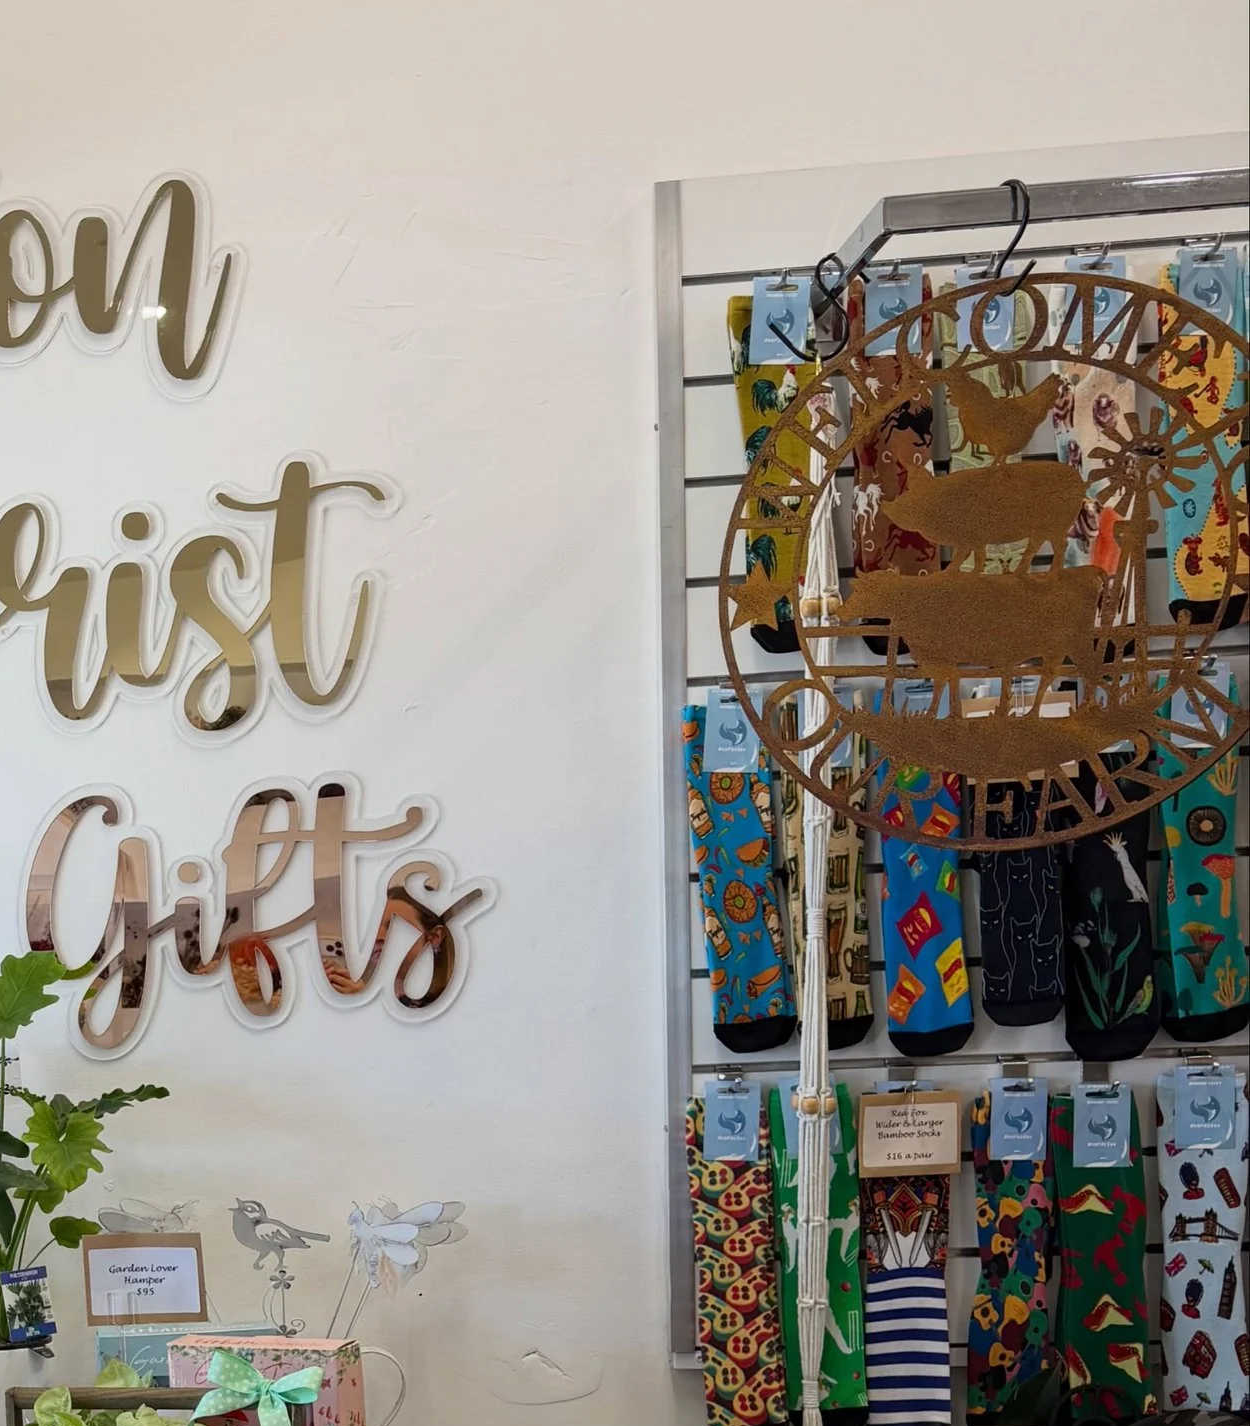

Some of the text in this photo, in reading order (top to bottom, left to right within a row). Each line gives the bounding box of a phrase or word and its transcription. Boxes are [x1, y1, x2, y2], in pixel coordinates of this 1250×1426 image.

[26, 783, 482, 1048] Gifts
[875, 1121, 901, 1129] Wider
[912, 1119, 944, 1129] Larger
[878, 1129, 941, 1139] Bamboo Socks
[886, 1152, 902, 1160] $16
[913, 1152, 934, 1161] pair
[108, 1263, 179, 1274] Garden Lover
[124, 1276, 165, 1286] Hamper
[136, 1287, 154, 1296] $95
